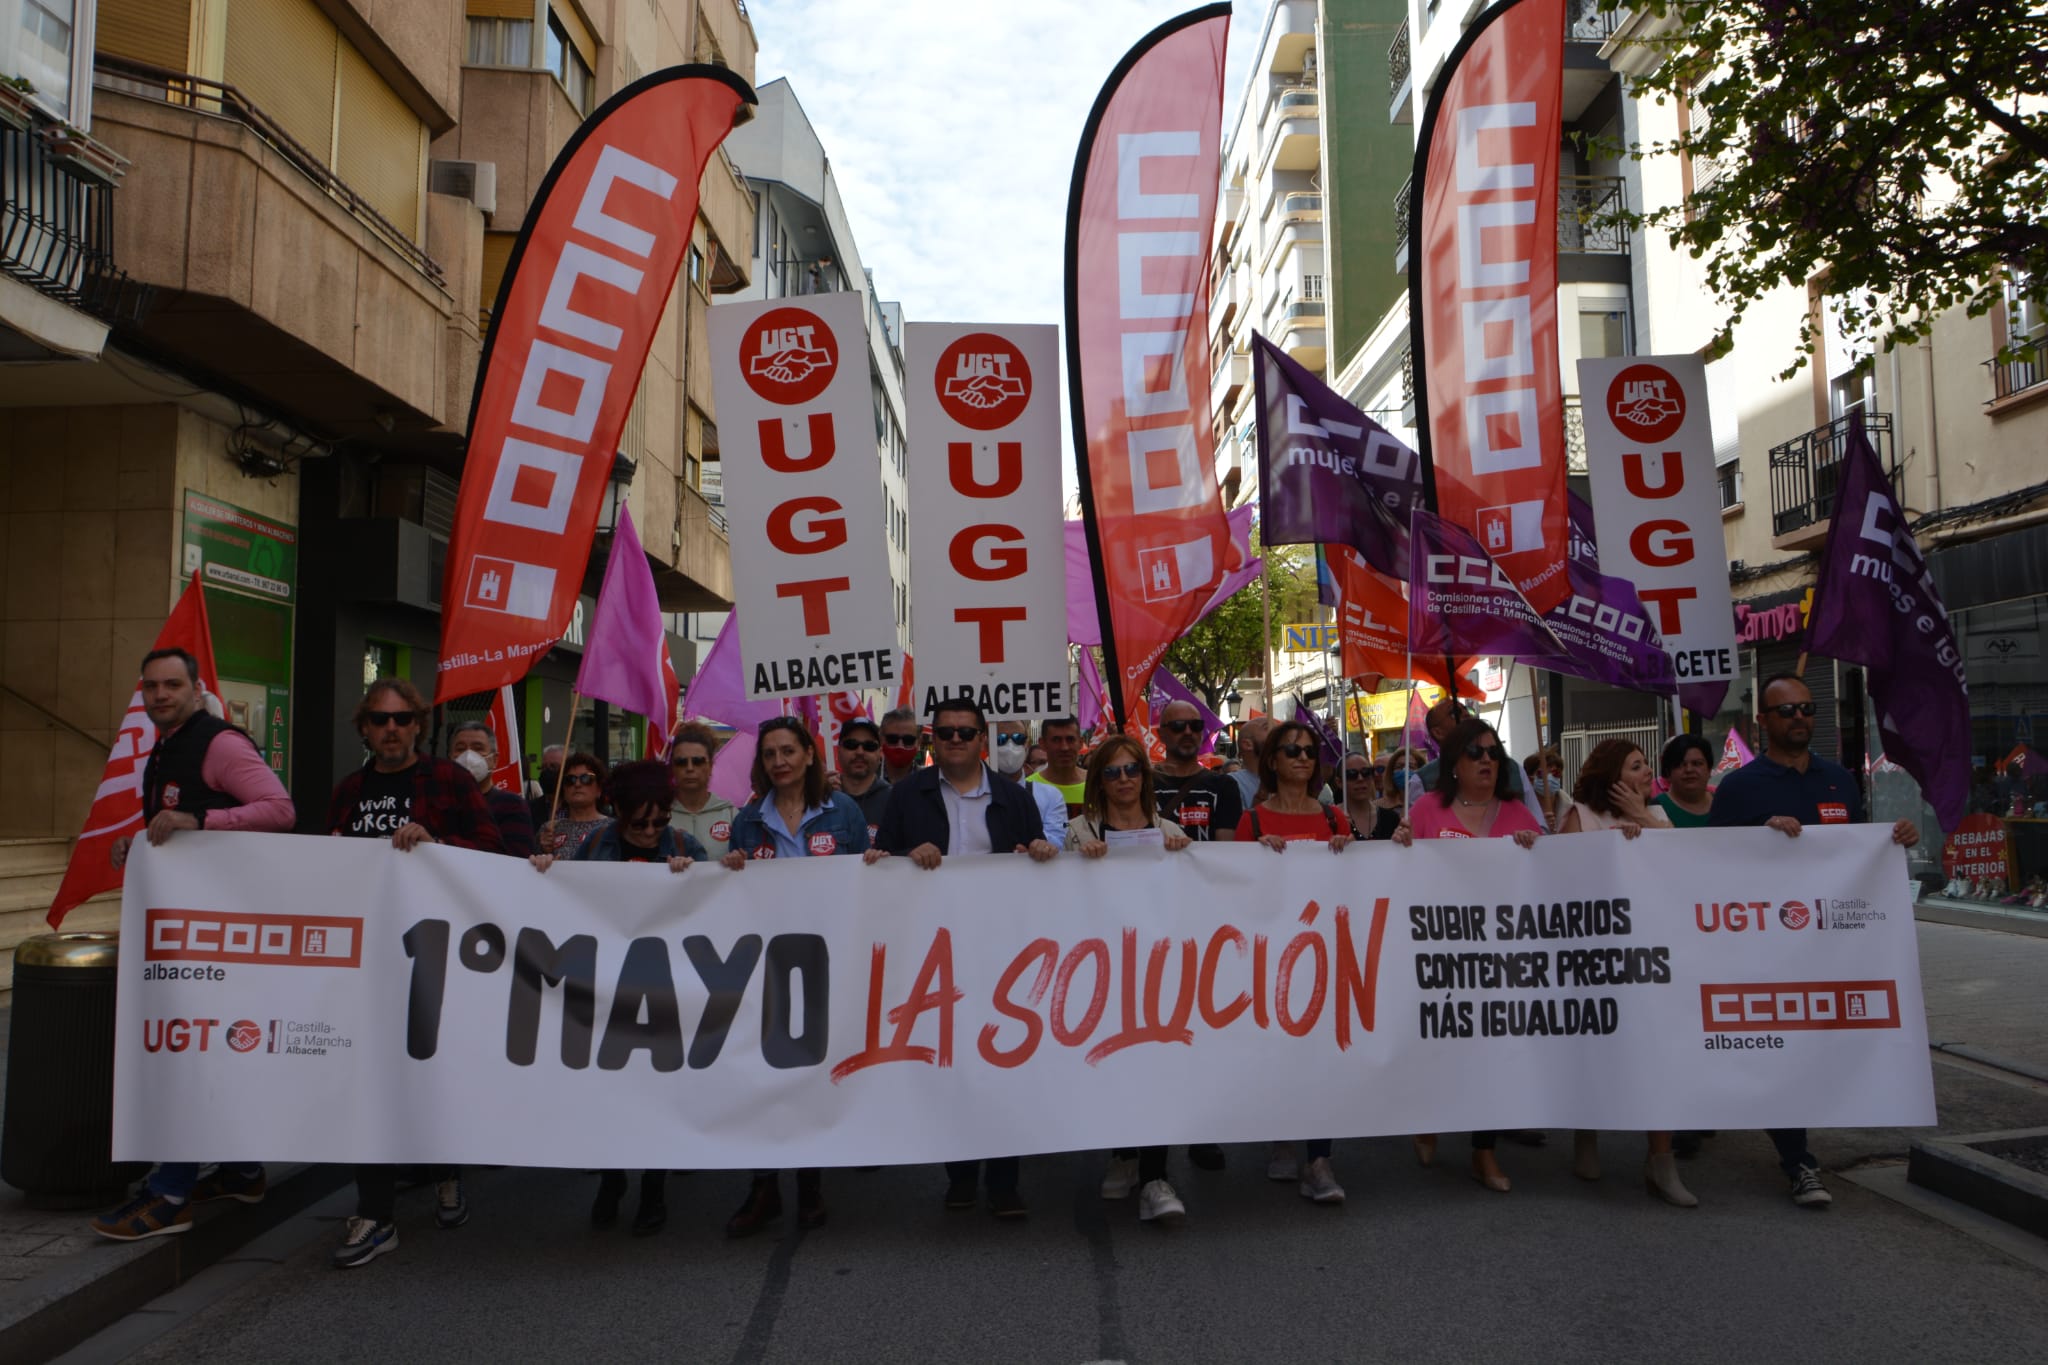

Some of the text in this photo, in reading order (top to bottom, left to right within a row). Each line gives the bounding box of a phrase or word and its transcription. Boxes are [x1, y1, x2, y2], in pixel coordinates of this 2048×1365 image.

[1456, 101, 1542, 475] CCOO
[1117, 130, 1205, 515] CCOO
[484, 144, 679, 535] CCOO
[760, 325, 815, 355] UGT
[956, 353, 1011, 379] UGT
[1624, 380, 1667, 402] UGT
[1427, 591, 1534, 612] Comisiones Obrera
[1545, 619, 1591, 638] omisiones
[753, 649, 894, 694] ALBACETE
[1675, 649, 1732, 678] CETE
[1954, 830, 2006, 846] REBAJAS
[1965, 846, 1992, 858] EN EL
[1952, 861, 2005, 877] INTERIOR
[1695, 901, 1772, 933] UGT
[1831, 899, 1870, 910] Castilla-
[1832, 910, 1886, 922] La Mancha
[1409, 898, 1632, 942] SUBIR SALARIOS
[1832, 921, 1866, 930] Albacete
[152, 919, 292, 955] CCOO
[143, 963, 226, 982] albacete
[1415, 946, 1672, 989] CONTENER PRECIOS
[830, 927, 966, 1085] LA
[977, 897, 1390, 1068] SOLUCIÓN
[1420, 992, 1619, 1039] MÁS IGUALDAD
[1710, 991, 1838, 1022] CCOO
[143, 1018, 220, 1054] UGT
[286, 1020, 337, 1034] Castilla-
[285, 1046, 327, 1056] Albacete
[286, 1034, 352, 1048] La Mancha
[1704, 1034, 1785, 1050] albacete
